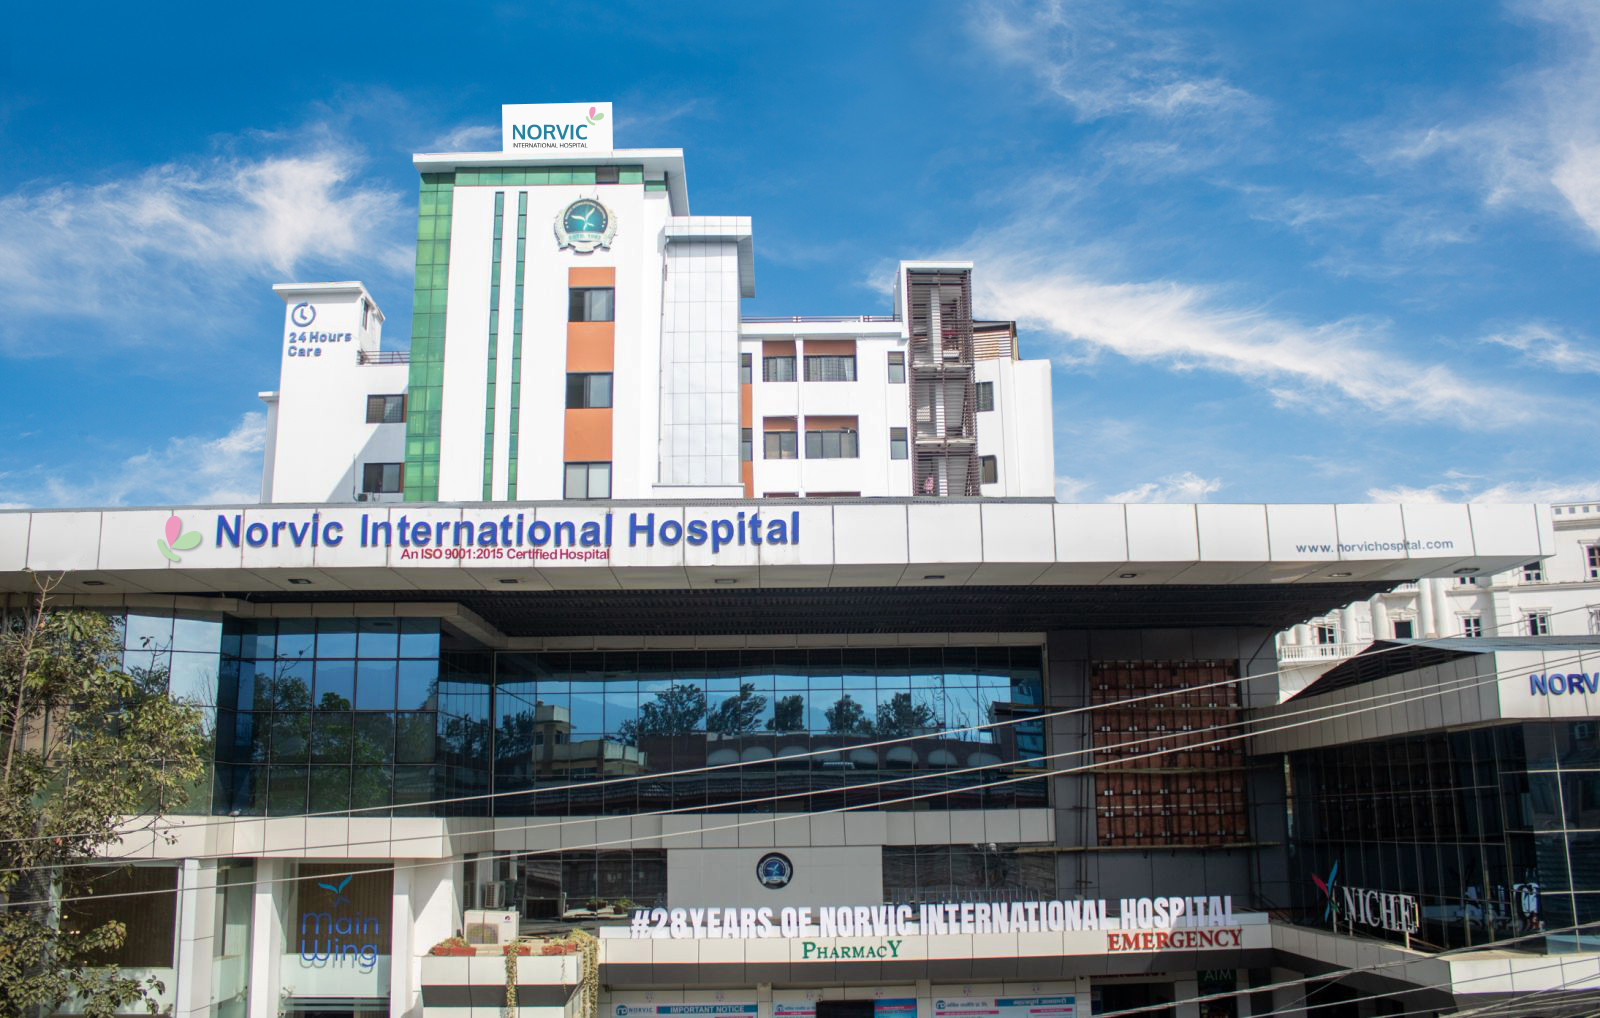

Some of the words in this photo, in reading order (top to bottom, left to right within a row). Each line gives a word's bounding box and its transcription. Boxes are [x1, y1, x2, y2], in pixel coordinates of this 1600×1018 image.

[512, 124, 588, 141] NORVIC
[289, 332, 307, 343] 24
[309, 331, 352, 343] Hours
[288, 346, 322, 357] Care
[215, 513, 343, 548] Norvic
[360, 513, 613, 547] International
[629, 511, 800, 554] Hospital
[401, 549, 419, 560] An
[421, 549, 442, 560] ISO
[444, 548, 503, 560] 9001:2015
[507, 548, 558, 561] Certified
[560, 548, 610, 562] Hospital
[1530, 672, 1600, 696] NORV
[781, 907, 813, 938] OF
[820, 905, 912, 938] NORVIC
[919, 899, 1110, 935] INTERNATIONAL
[1120, 896, 1238, 929] HOSPITAL
[1341, 886, 1417, 934] NICHE
[301, 912, 379, 935] Main
[1107, 929, 1243, 951] EMERGENCY
[301, 938, 378, 967] Wing
[670, 1005, 714, 1014] IMPORTANT
[715, 1005, 745, 1013] NOTICE
